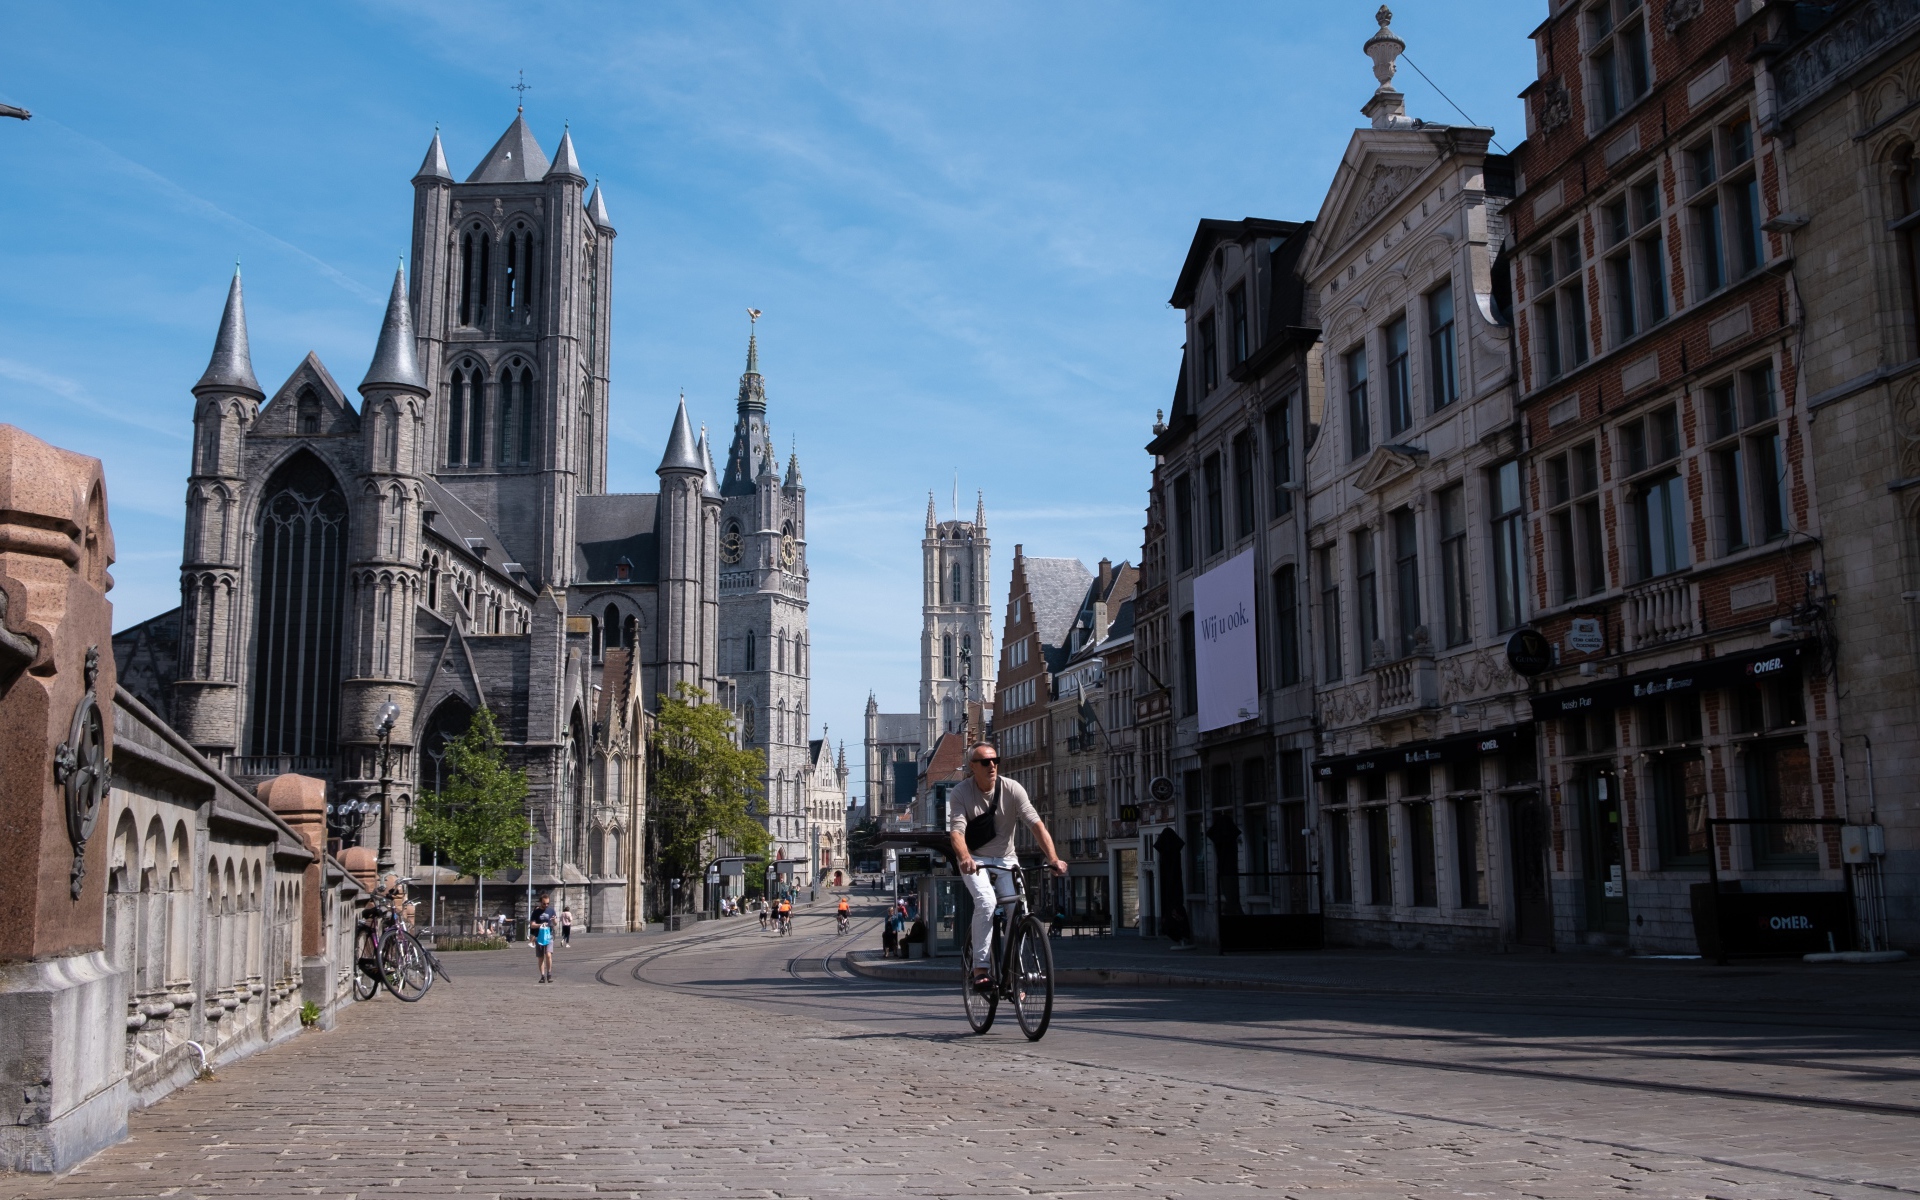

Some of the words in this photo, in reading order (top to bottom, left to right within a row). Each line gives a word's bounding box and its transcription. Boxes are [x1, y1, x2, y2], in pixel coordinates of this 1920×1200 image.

[1201, 614, 1217, 643] Wij
[1219, 618, 1226, 634] u
[1227, 601, 1249, 631] ook.
[1769, 915, 1814, 930] OMER.
